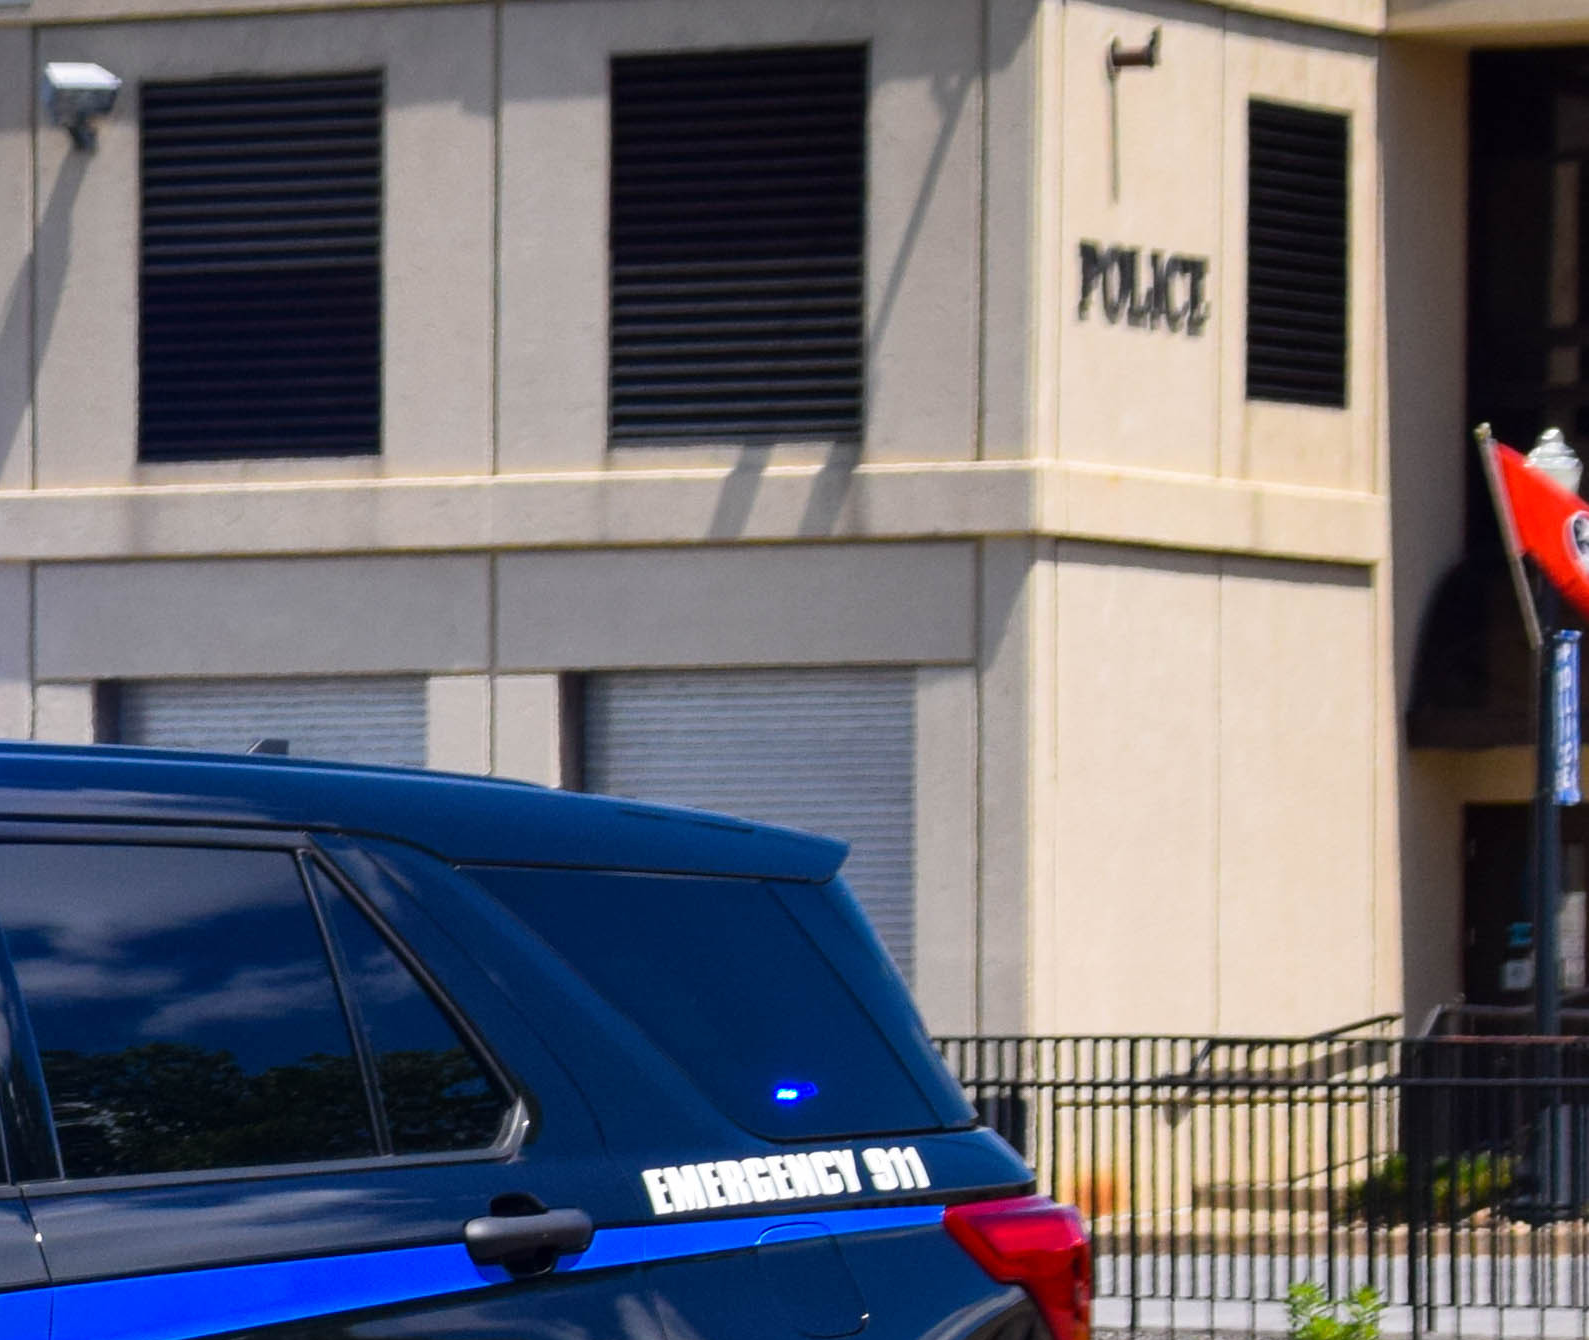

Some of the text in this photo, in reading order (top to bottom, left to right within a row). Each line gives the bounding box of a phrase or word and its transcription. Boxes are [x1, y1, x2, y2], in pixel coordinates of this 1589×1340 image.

[1078, 238, 1210, 337] POLICE
[641, 1146, 931, 1216] EMERGENCY 911
